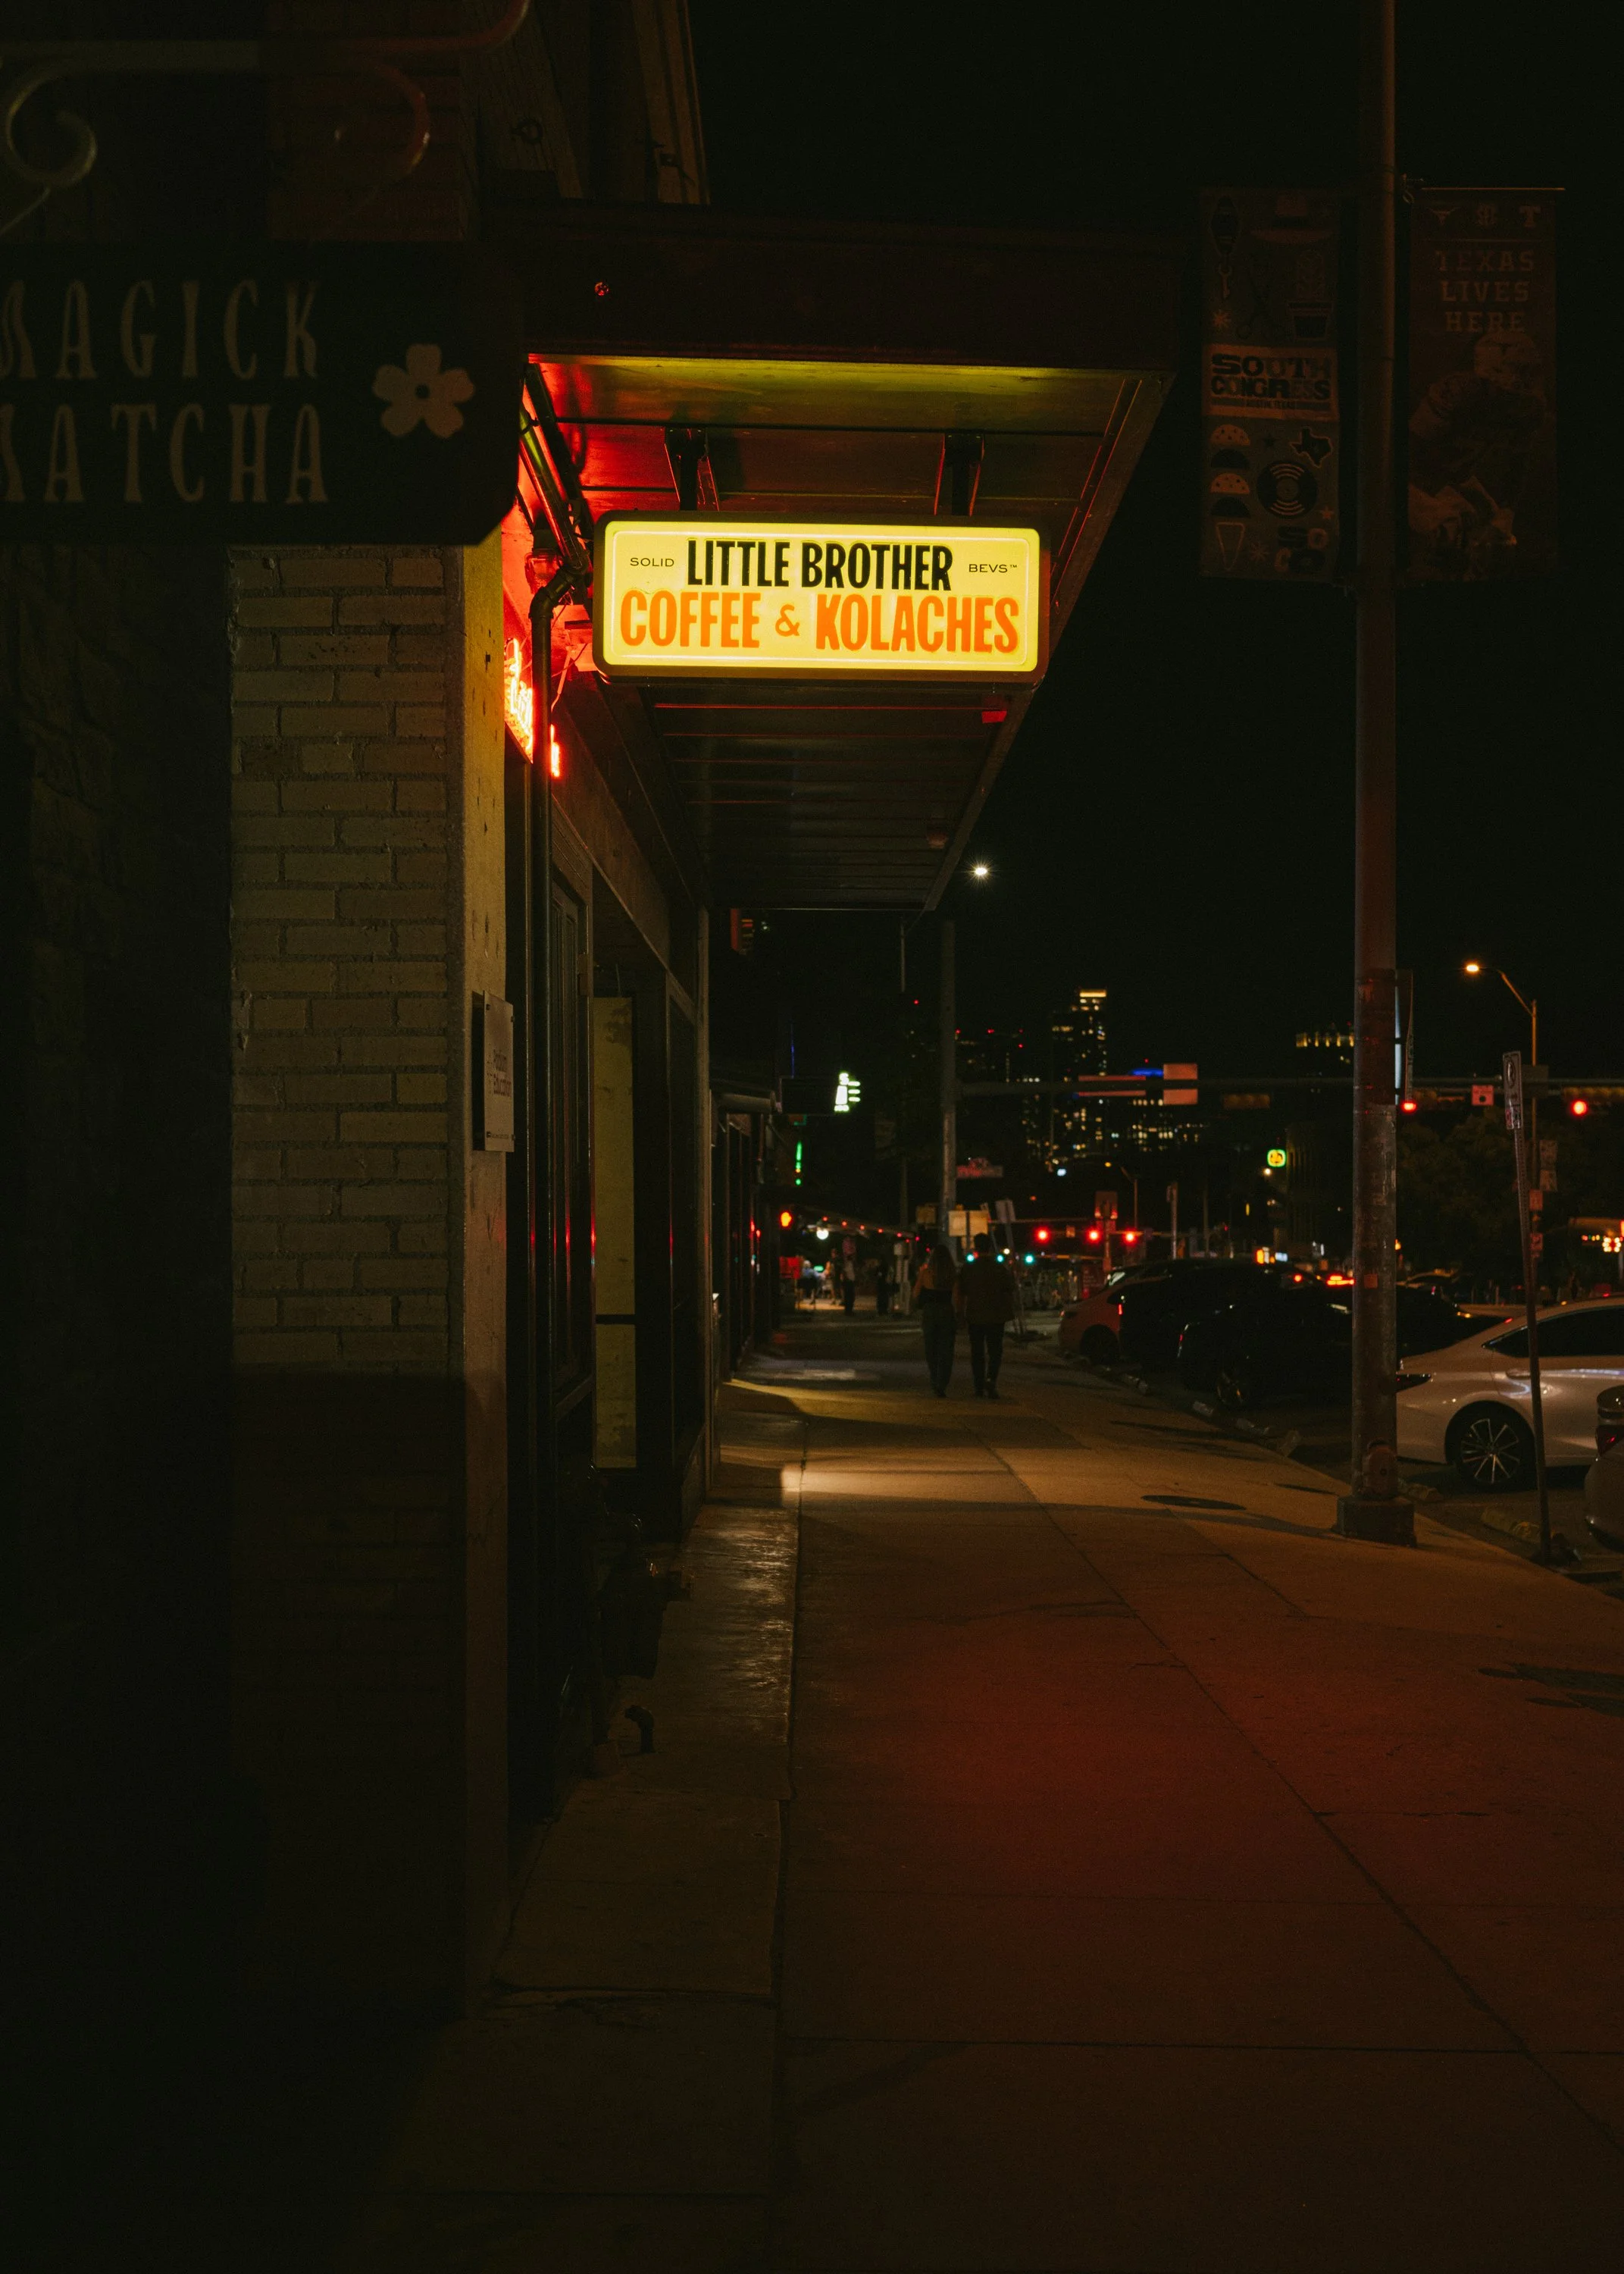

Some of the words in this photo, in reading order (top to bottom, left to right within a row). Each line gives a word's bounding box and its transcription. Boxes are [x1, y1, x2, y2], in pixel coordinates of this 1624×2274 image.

[1435, 249, 1535, 272] TEXAS
[1440, 280, 1530, 302] LIVES
[1444, 311, 1525, 334] HERE
[1212, 353, 1331, 379] SOUTH
[1211, 375, 1331, 400] CONGRESS
[630, 557, 674, 568] SOLID
[687, 540, 790, 587] LITTLE
[801, 542, 953, 591] BROTHER
[620, 590, 761, 648] COFFEE
[774, 604, 800, 637] &
[815, 594, 1020, 655] KOLACHES
